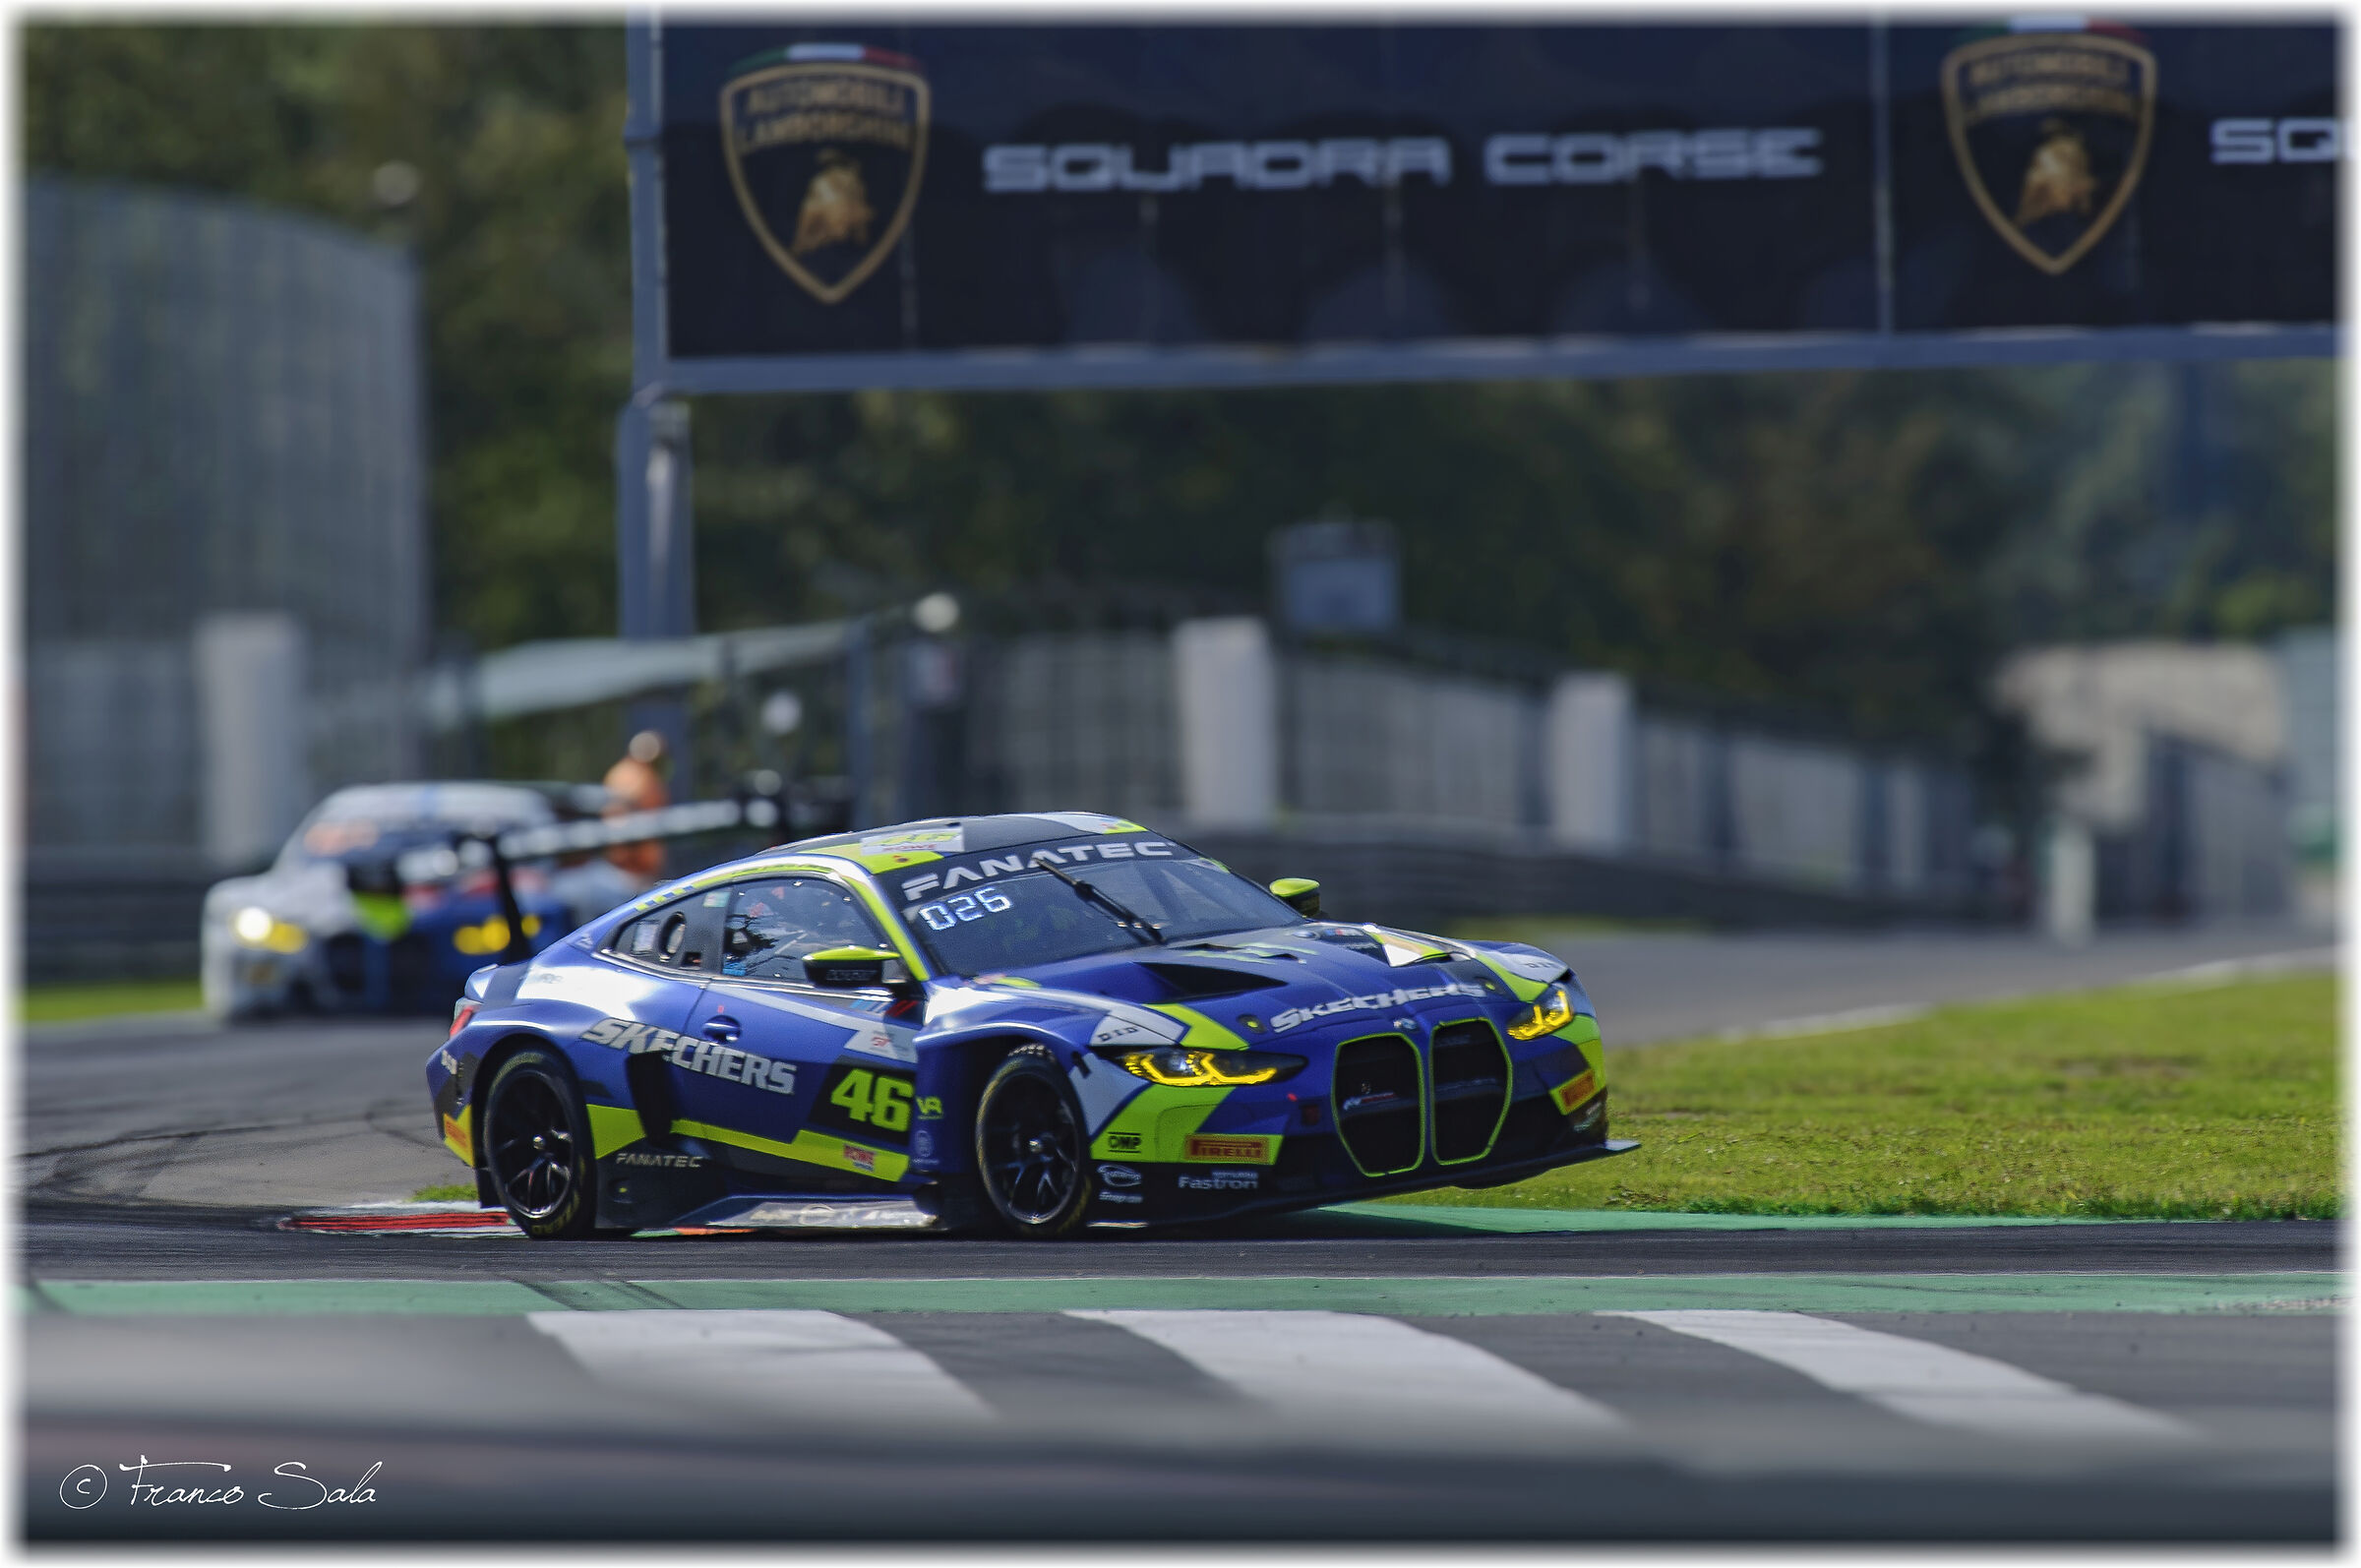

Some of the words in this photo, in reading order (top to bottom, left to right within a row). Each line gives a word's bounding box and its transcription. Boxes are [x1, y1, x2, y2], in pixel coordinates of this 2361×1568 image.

[984, 137, 1449, 194] SQUADRA
[1484, 128, 1823, 185] CORSE
[2210, 116, 2345, 164] SQ
[900, 841, 1174, 902] FANATEC
[918, 886, 1012, 932] 026
[1269, 984, 1487, 1034] SKECHERS
[579, 1016, 798, 1096] SKECHERS
[830, 1067, 915, 1132] 46
[616, 1152, 702, 1169] FANATEC
[1108, 1135, 1142, 1150] OMP
[1190, 1138, 1263, 1158] PIRELLI
[1178, 1175, 1258, 1189] Fastron
